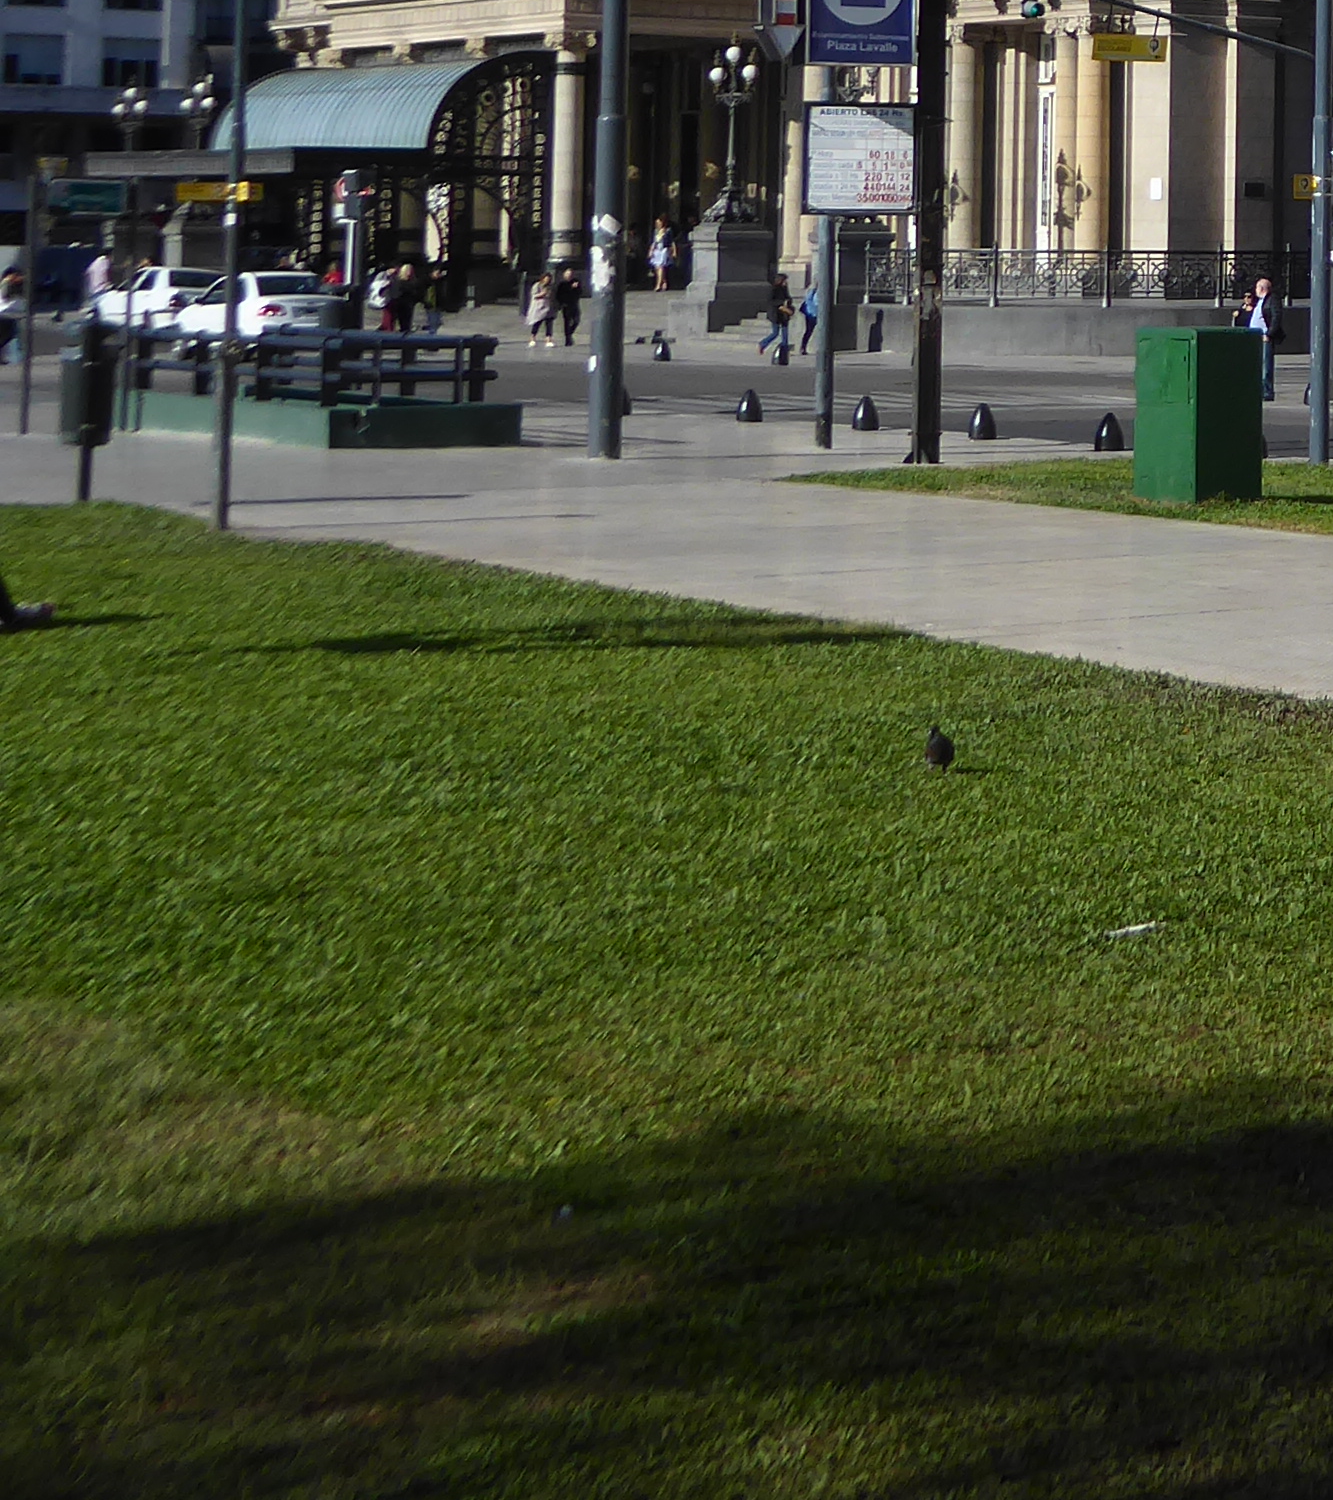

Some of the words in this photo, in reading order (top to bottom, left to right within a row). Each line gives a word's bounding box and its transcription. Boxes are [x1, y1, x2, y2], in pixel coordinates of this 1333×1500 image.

[827, 40, 857, 50] Plaza
[860, 41, 898, 52] Lavalle
[820, 108, 858, 116] ABIERTO
